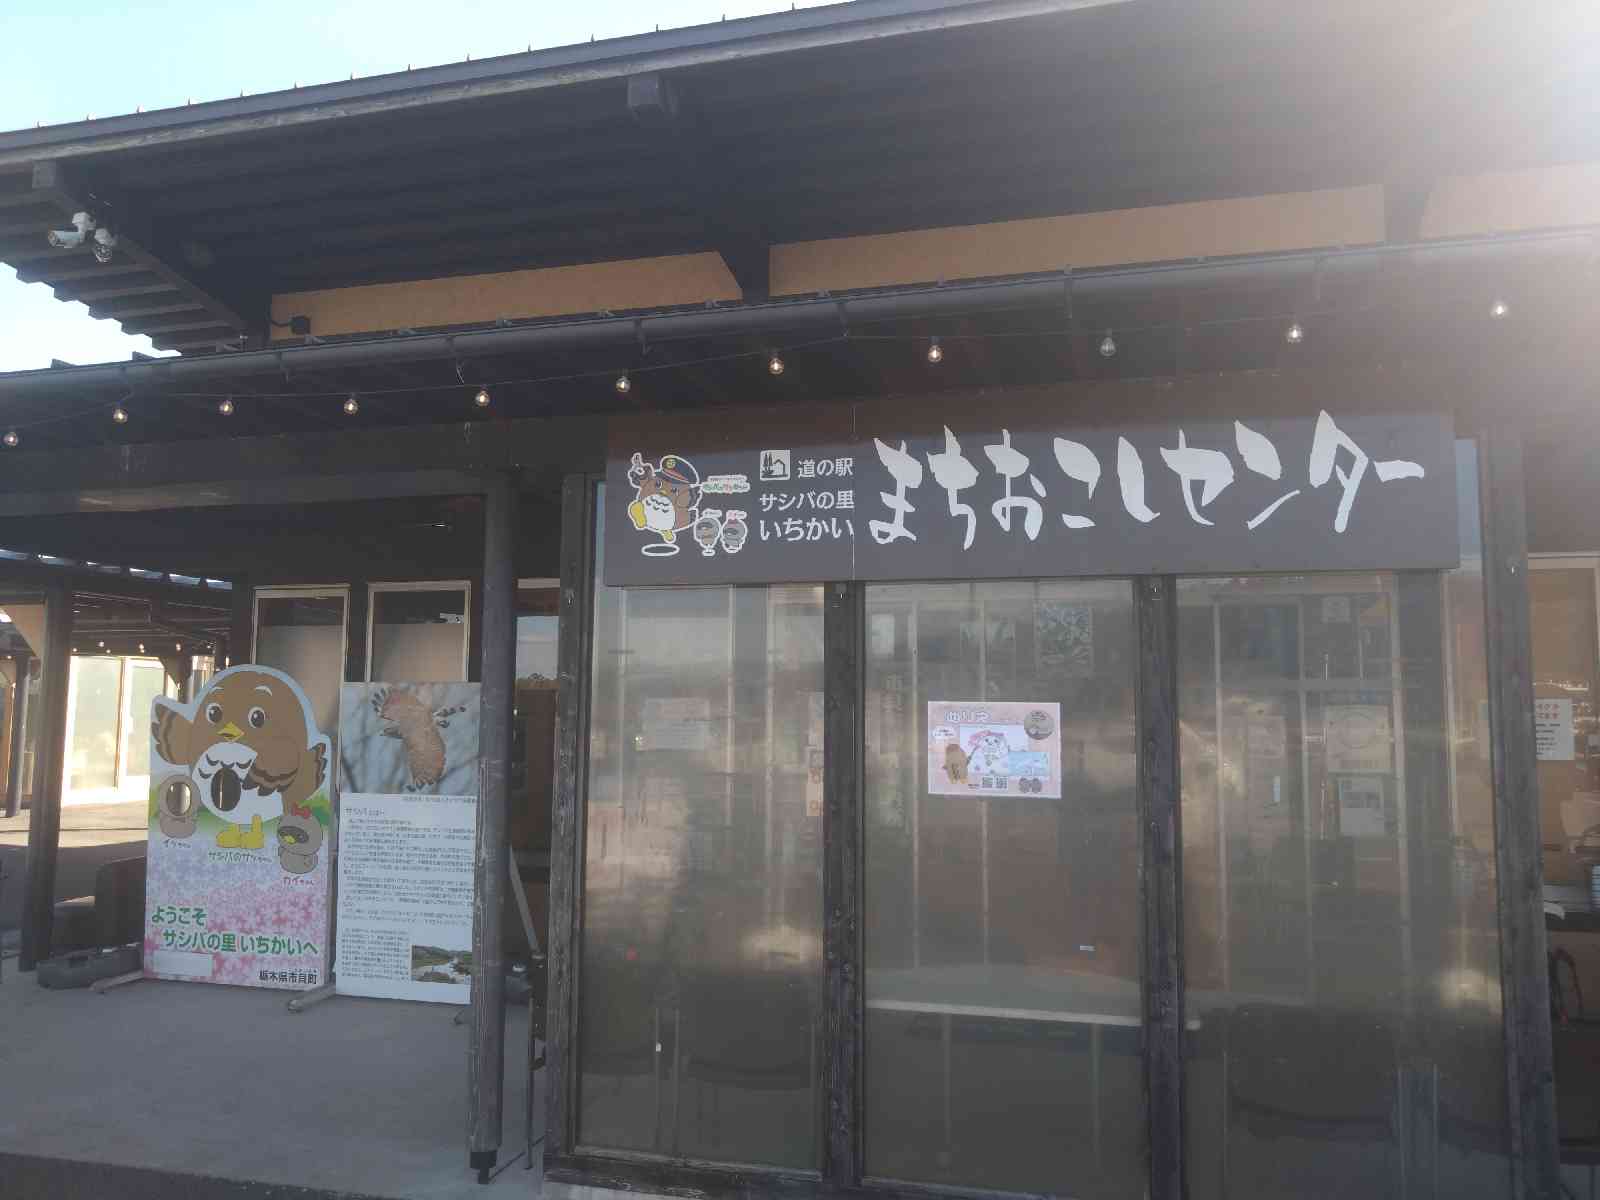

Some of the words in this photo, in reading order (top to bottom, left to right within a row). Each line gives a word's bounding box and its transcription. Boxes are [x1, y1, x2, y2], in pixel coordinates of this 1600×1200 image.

[797, 457, 854, 479] 道の駅
[868, 409, 1426, 550] まちおこしセンター
[759, 490, 855, 512] サシバの里
[759, 517, 854, 542] いちかい
[151, 905, 207, 927] ようこそ
[258, 970, 318, 985] 栃木県市貝町
